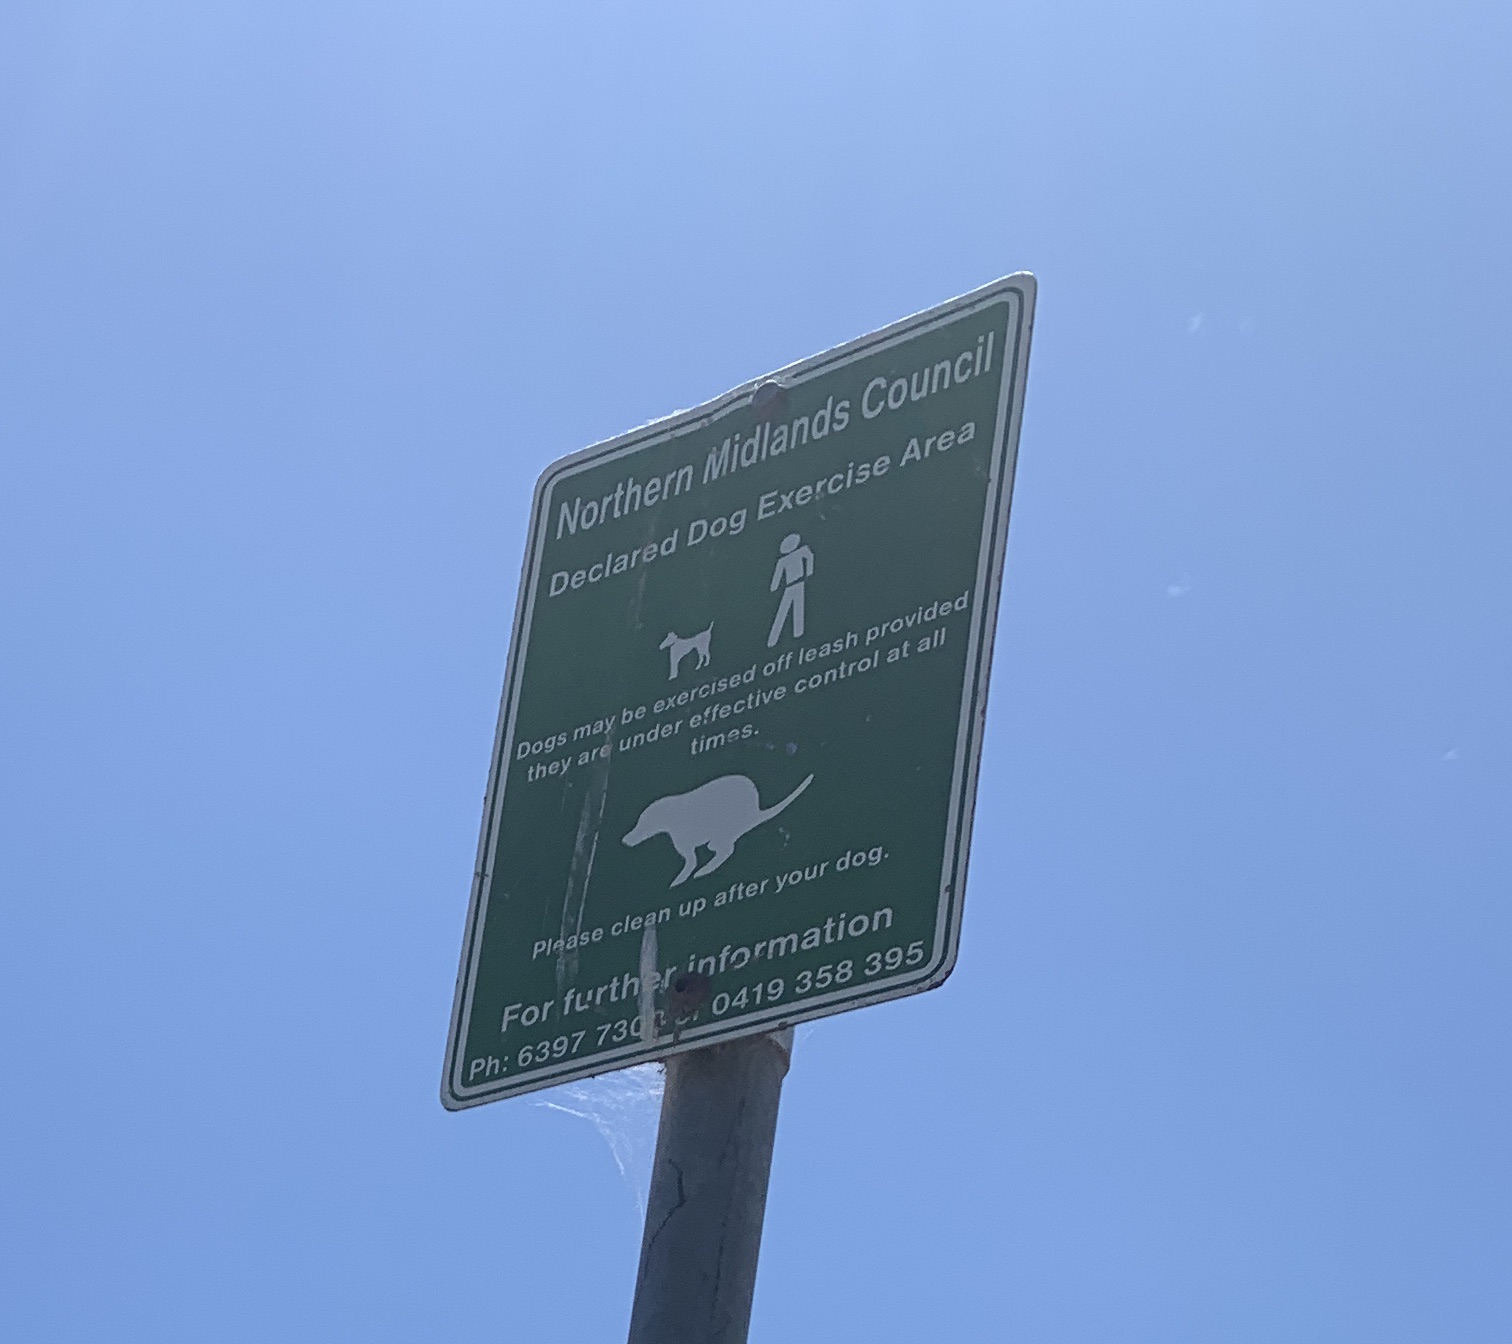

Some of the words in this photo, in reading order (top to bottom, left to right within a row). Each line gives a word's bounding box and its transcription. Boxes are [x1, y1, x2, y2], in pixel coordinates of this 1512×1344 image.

[549, 530, 679, 596] Declared
[688, 506, 747, 548] Dog
[757, 455, 890, 520] Exercise
[899, 421, 976, 467] Area
[556, 464, 693, 539] Northern
[703, 395, 849, 484] Midlands
[861, 331, 995, 419] Council
[516, 733, 567, 760] Dogs
[573, 715, 616, 739] may
[621, 704, 646, 725] be
[653, 665, 756, 713] exercised
[762, 652, 792, 678] off
[798, 632, 858, 665] leash
[865, 591, 969, 650] provided
[527, 757, 572, 782] they
[578, 744, 611, 766] are
[619, 720, 683, 752] under
[689, 686, 786, 728] effective
[794, 650, 879, 694] control
[886, 640, 910, 663] at
[917, 627, 946, 654] all
[690, 727, 759, 755] times.
[501, 1000, 554, 1032] For
[688, 906, 893, 977] information
[532, 927, 603, 960] Please
[611, 907, 671, 935] clean
[678, 896, 707, 918] up
[714, 877, 769, 908] after
[774, 860, 828, 892] your
[835, 844, 890, 873] dog.
[469, 1055, 509, 1081] Ph:
[518, 1031, 586, 1068] 6397
[712, 978, 785, 1016] 0419
[795, 960, 853, 996] 358
[864, 941, 926, 977] 395
